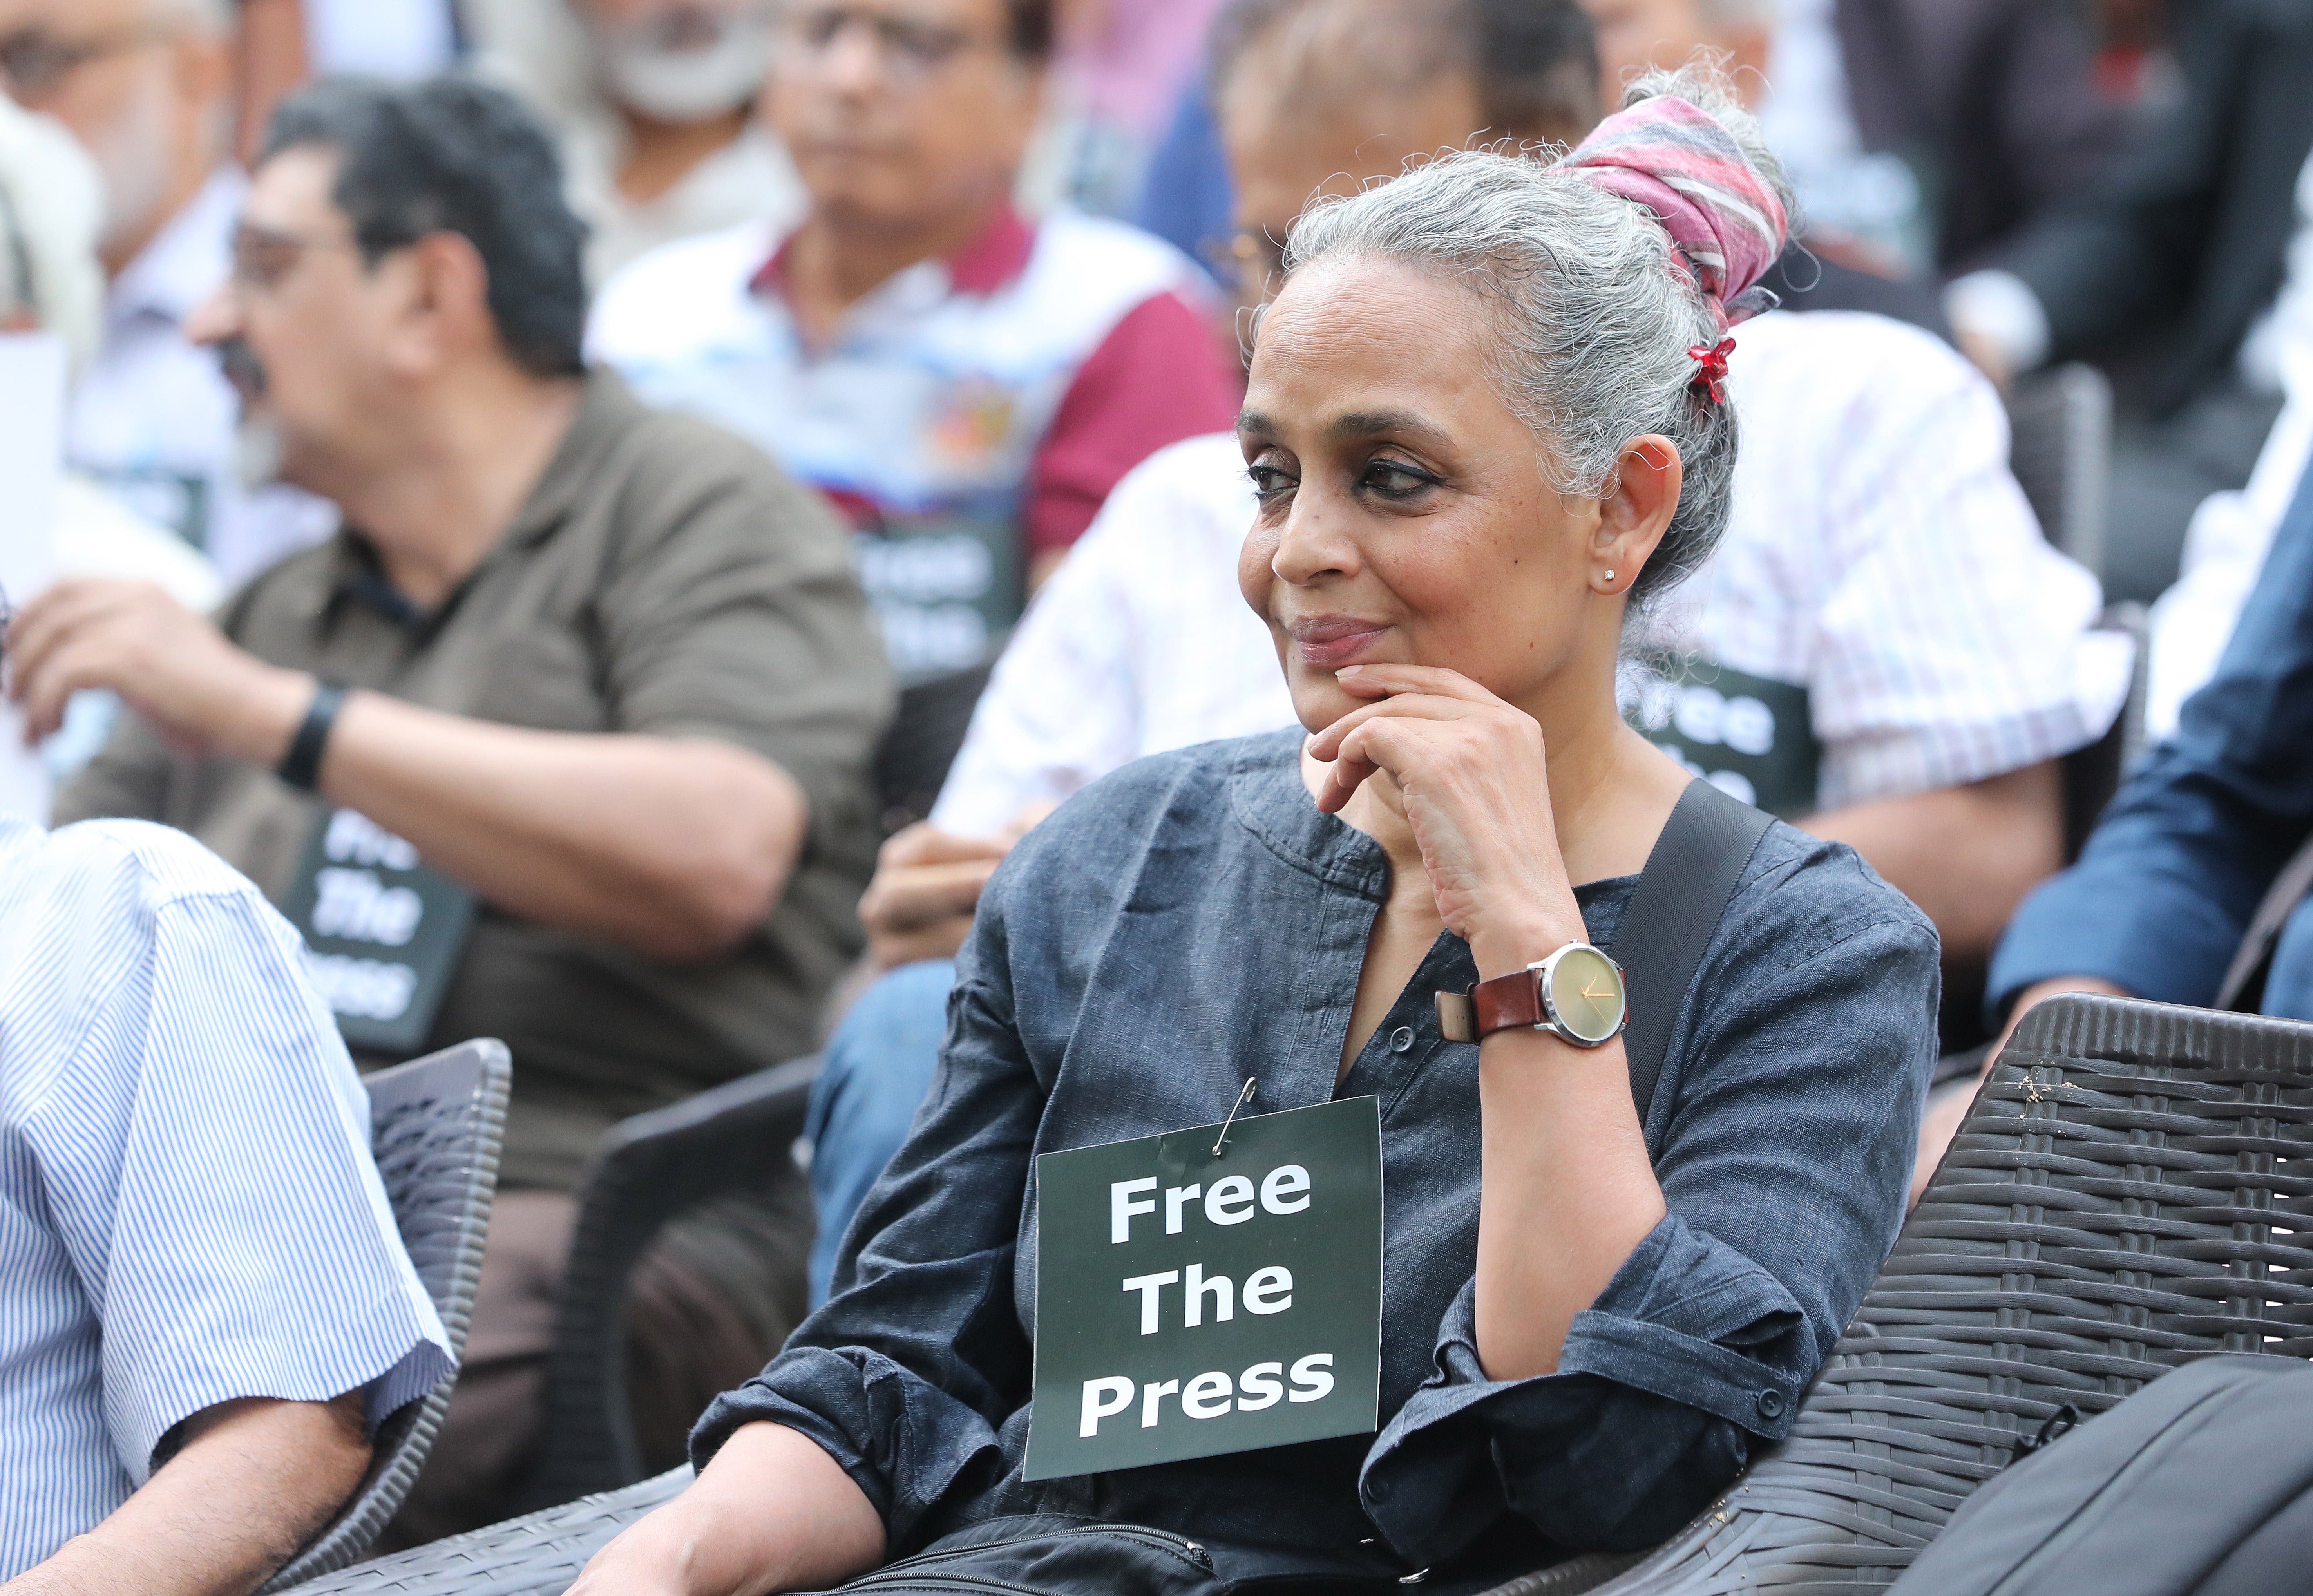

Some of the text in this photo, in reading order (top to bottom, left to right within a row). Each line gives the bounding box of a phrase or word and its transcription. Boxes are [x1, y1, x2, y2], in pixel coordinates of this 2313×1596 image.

[1111, 1165, 1310, 1244] Free
[1122, 1263, 1293, 1335] The
[1079, 1353, 1335, 1438] Press
